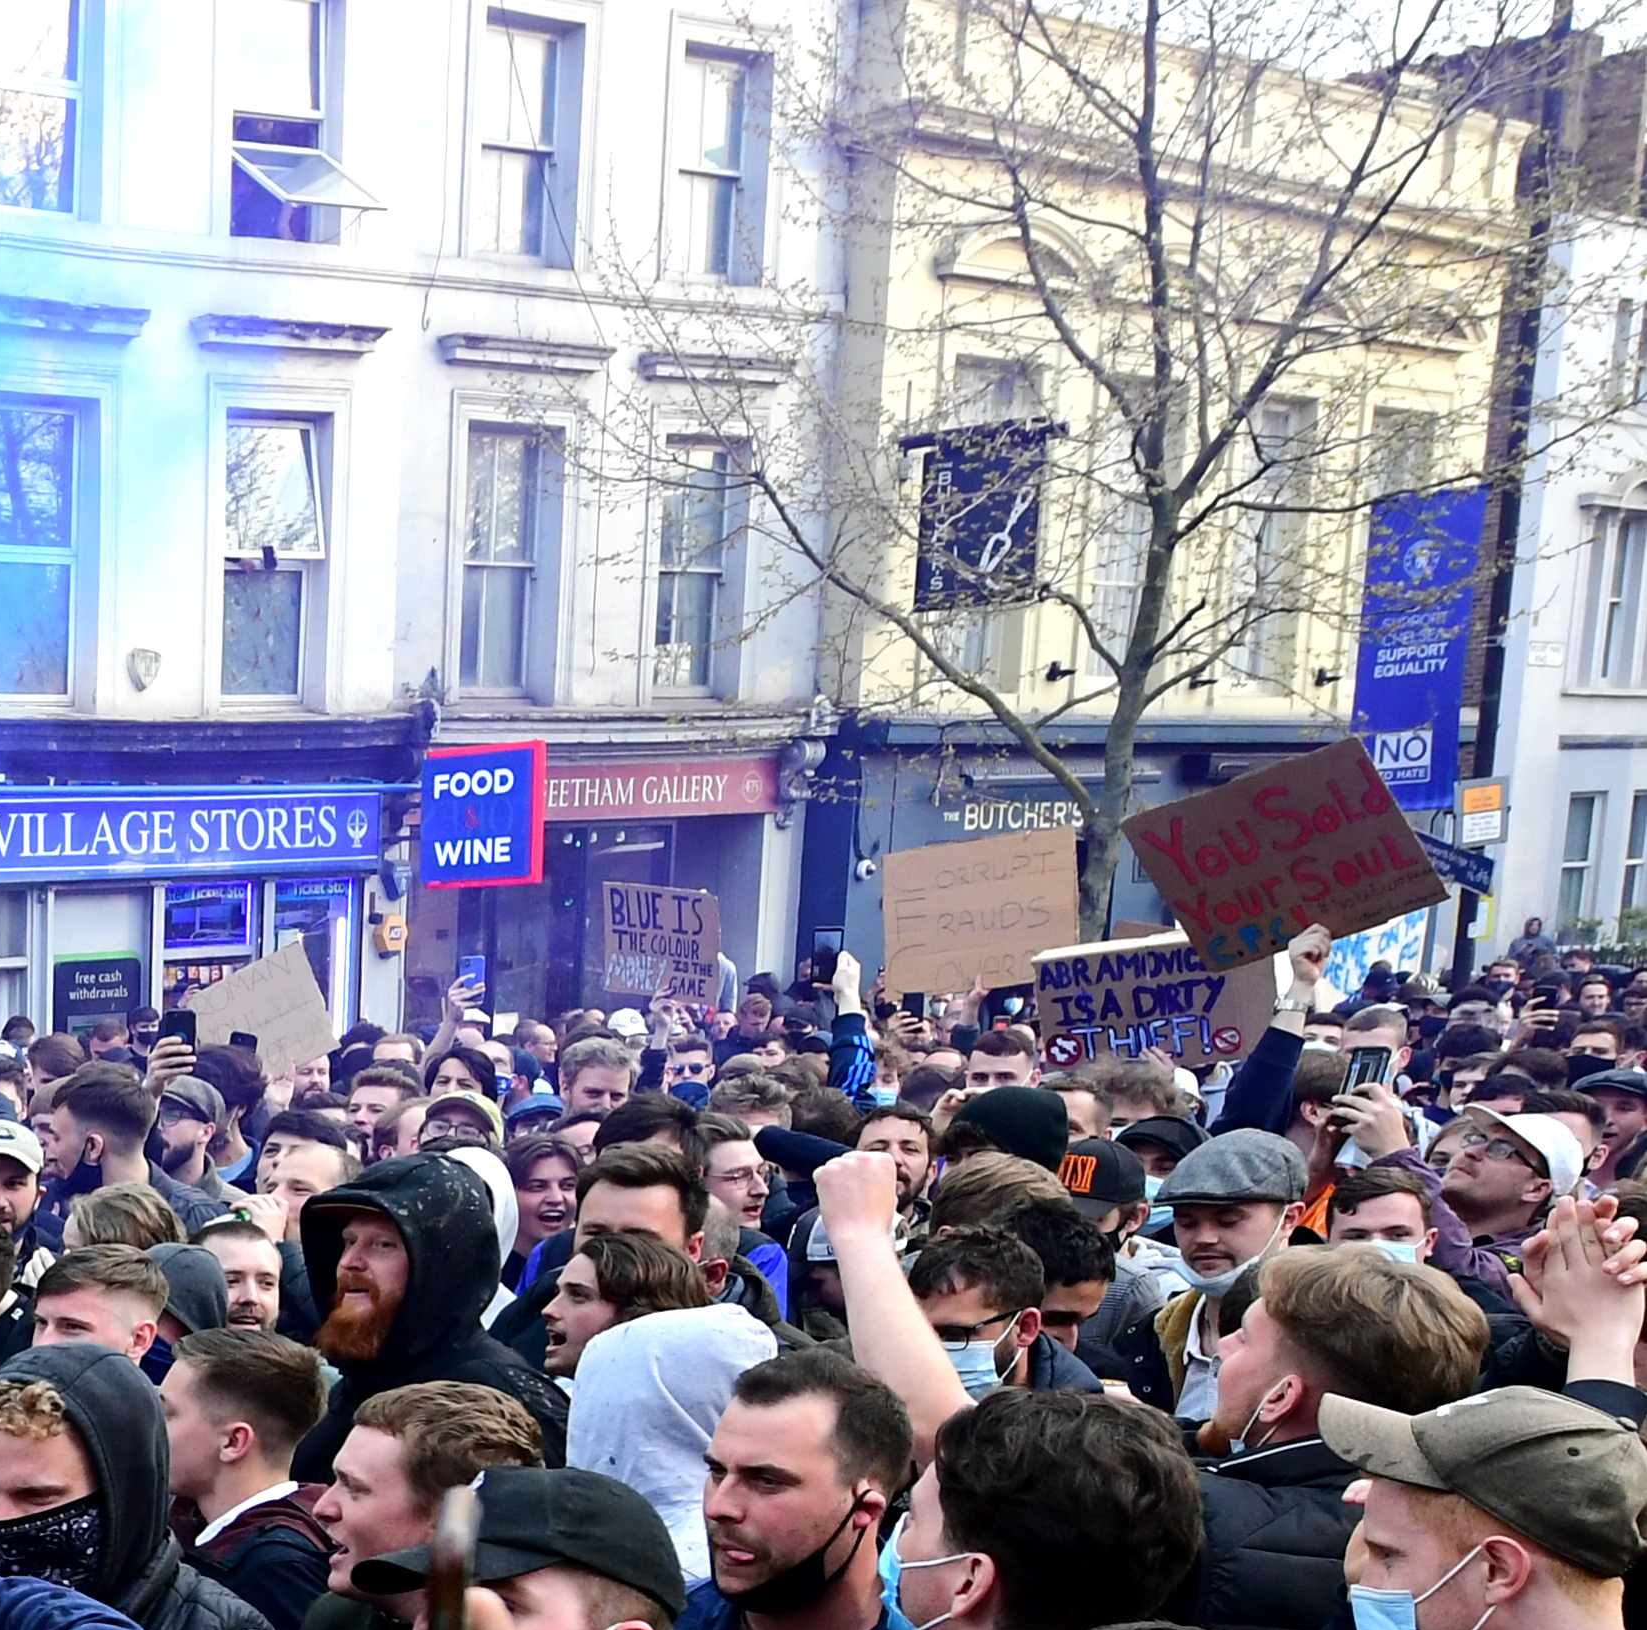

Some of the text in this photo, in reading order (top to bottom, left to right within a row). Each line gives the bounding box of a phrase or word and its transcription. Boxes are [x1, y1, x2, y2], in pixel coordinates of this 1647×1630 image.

[1376, 642, 1449, 663] SUPPORT
[1374, 657, 1449, 679] EQUALITY
[1379, 735, 1428, 763] NO
[433, 768, 514, 799] FOOD
[744, 780, 761, 794] 475
[1396, 766, 1427, 780] HATE
[642, 775, 729, 805] GALLERY
[189, 805, 338, 852] STORES
[464, 808, 479, 830] &
[943, 801, 1084, 831] THE BUTCHER'S
[434, 837, 511, 867] WINE
[892, 851, 1056, 893] CORRUPT
[610, 887, 703, 935] BLUE IS
[895, 896, 1052, 942] FRAUDS
[612, 929, 699, 960] THE COLOUR
[75, 970, 122, 984] free cash
[673, 960, 689, 973] IS
[692, 963, 713, 977] THE
[68, 986, 129, 1000] withdrawals
[196, 953, 291, 1020] ROMAN
[669, 977, 706, 998] GAME
[1100, 988, 1123, 1021] A
[1133, 975, 1226, 1020] DIRTY
[1069, 1014, 1212, 1060] THIEF!
